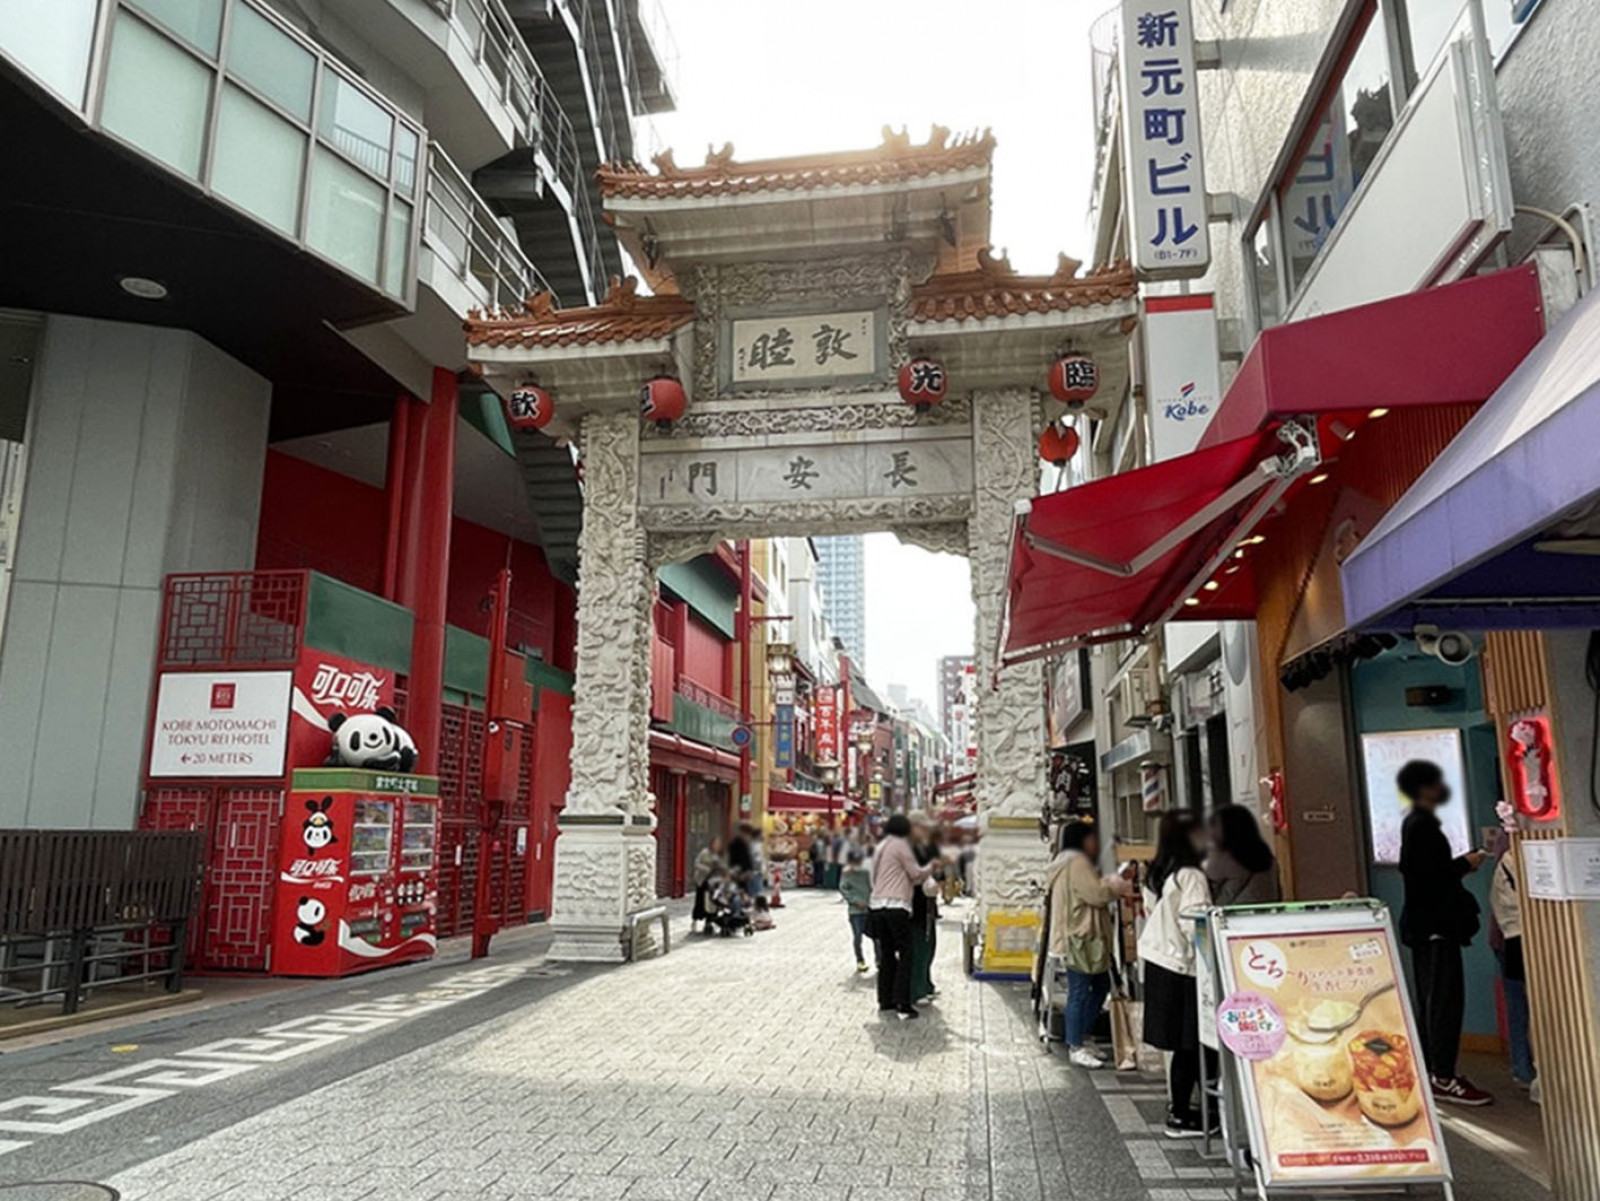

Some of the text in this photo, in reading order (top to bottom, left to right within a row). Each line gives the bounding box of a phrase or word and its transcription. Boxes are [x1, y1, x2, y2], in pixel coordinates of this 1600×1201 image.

[1137, 11, 1198, 247] 新元町ビル
[911, 363, 943, 393] 光
[1064, 358, 1096, 390] 臨
[1164, 401, 1209, 421] Kobe
[162, 719, 277, 732] KOBE MOTOMACHI
[168, 733, 209, 746] TOKYU
[232, 733, 271, 745] HOTEL
[192, 752, 254, 765] 20 METERS
